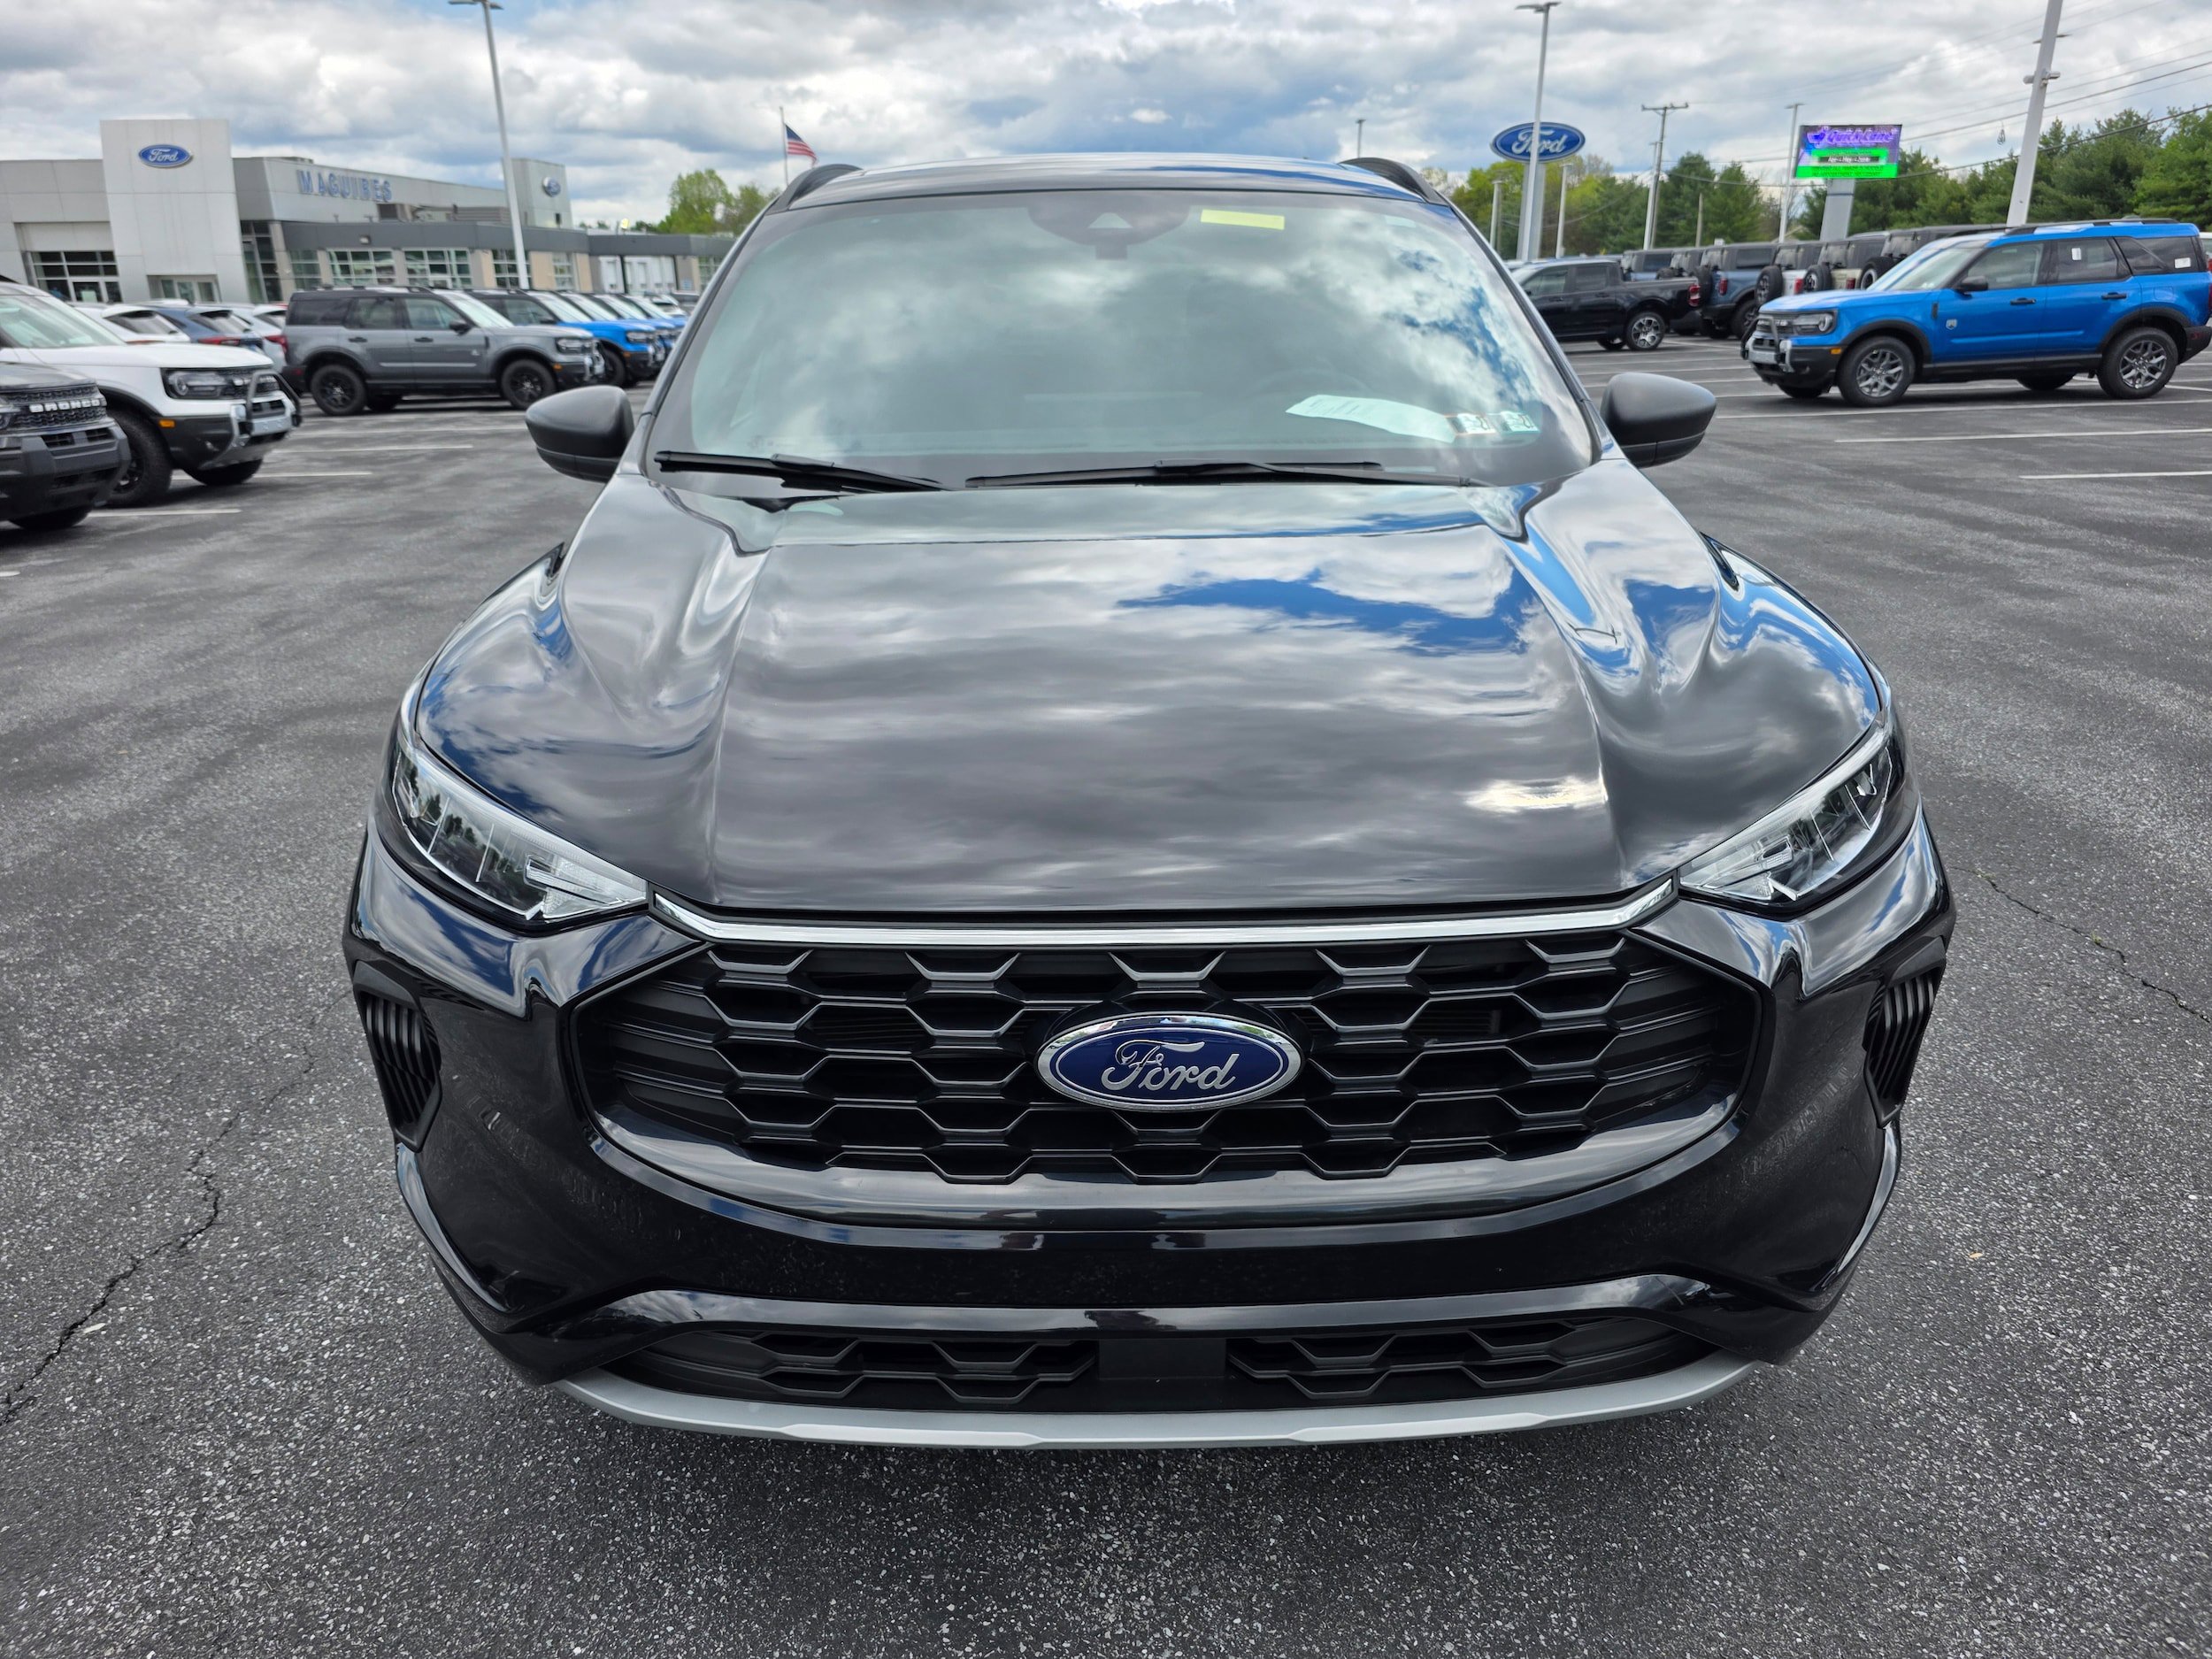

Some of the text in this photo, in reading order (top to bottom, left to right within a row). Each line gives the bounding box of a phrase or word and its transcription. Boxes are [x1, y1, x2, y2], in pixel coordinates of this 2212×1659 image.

[149, 148, 179, 162] Ford
[29, 398, 101, 413] BRONCO
[1101, 1040, 1240, 1091] Ford
